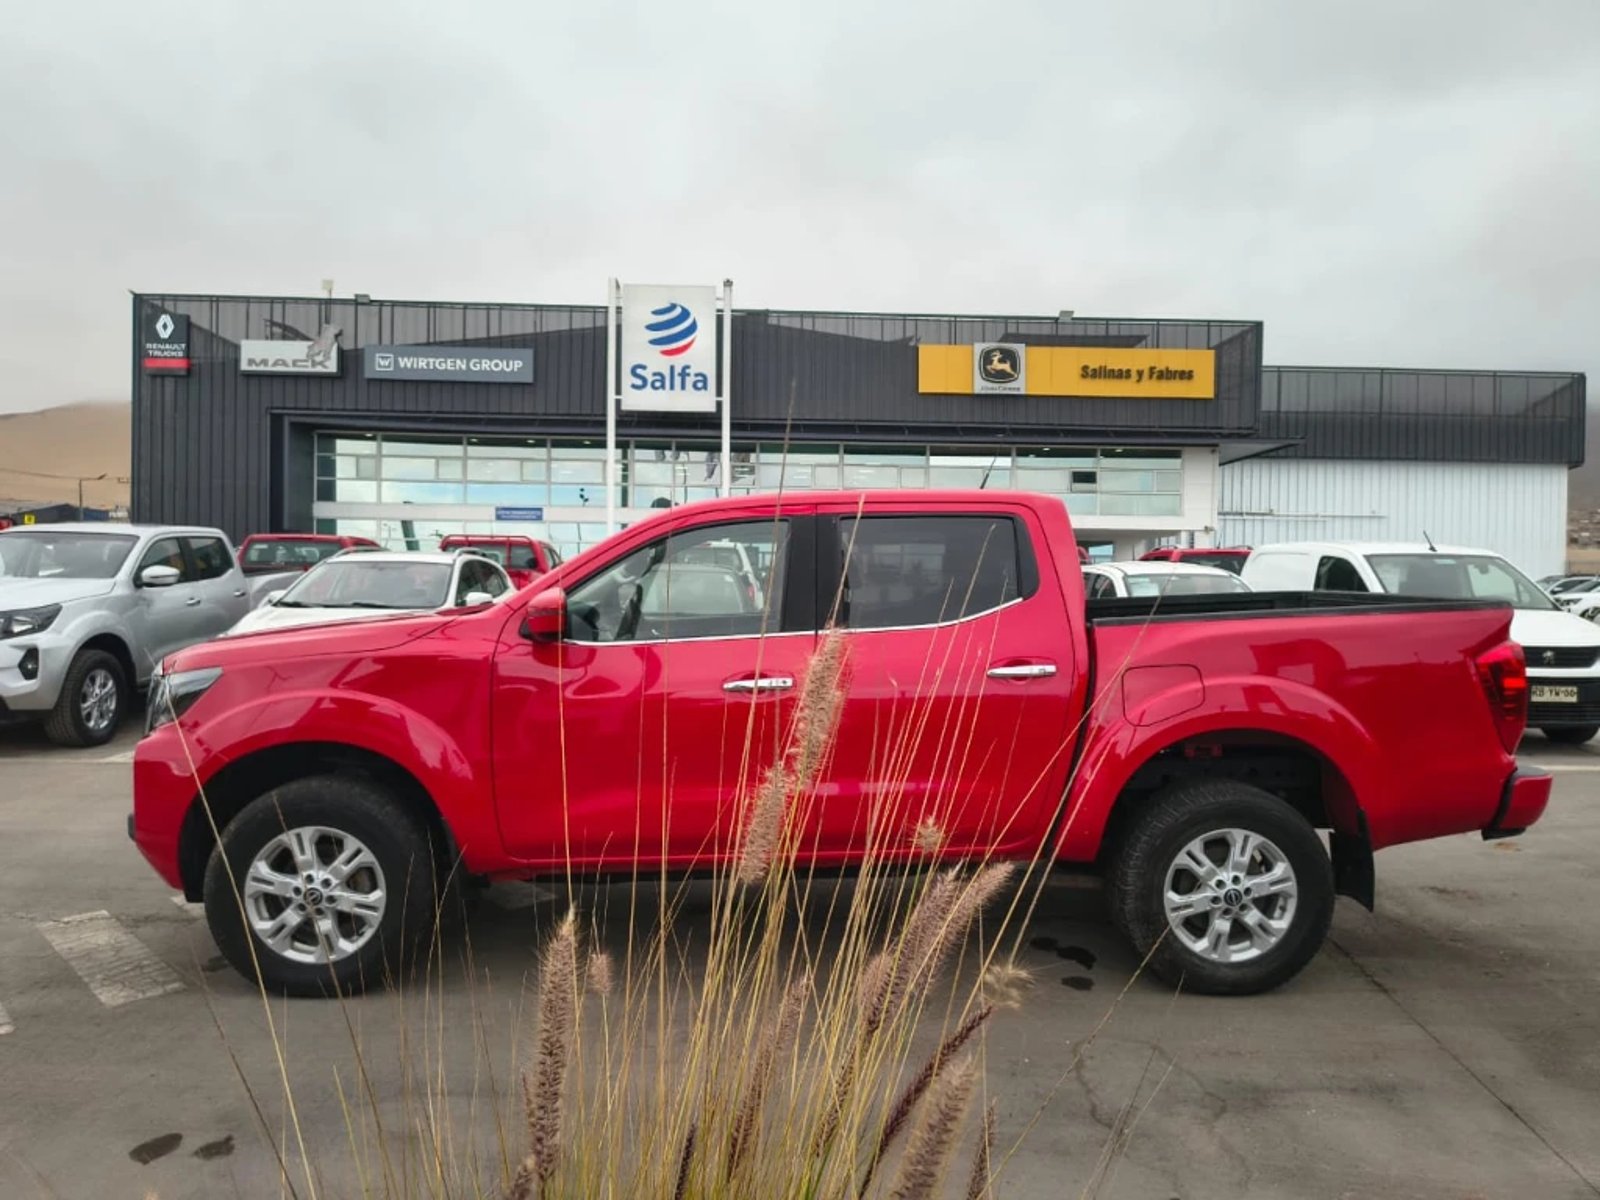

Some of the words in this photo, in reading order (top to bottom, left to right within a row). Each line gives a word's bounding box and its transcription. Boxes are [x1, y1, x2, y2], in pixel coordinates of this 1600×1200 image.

[247, 358, 330, 369] MACK
[398, 357, 467, 370] WIRTGEN
[469, 358, 523, 372] GROUP
[630, 363, 708, 391] Salfa
[1080, 364, 1132, 379] Salinas
[1136, 369, 1145, 383] y
[1149, 366, 1194, 380] Fabres
